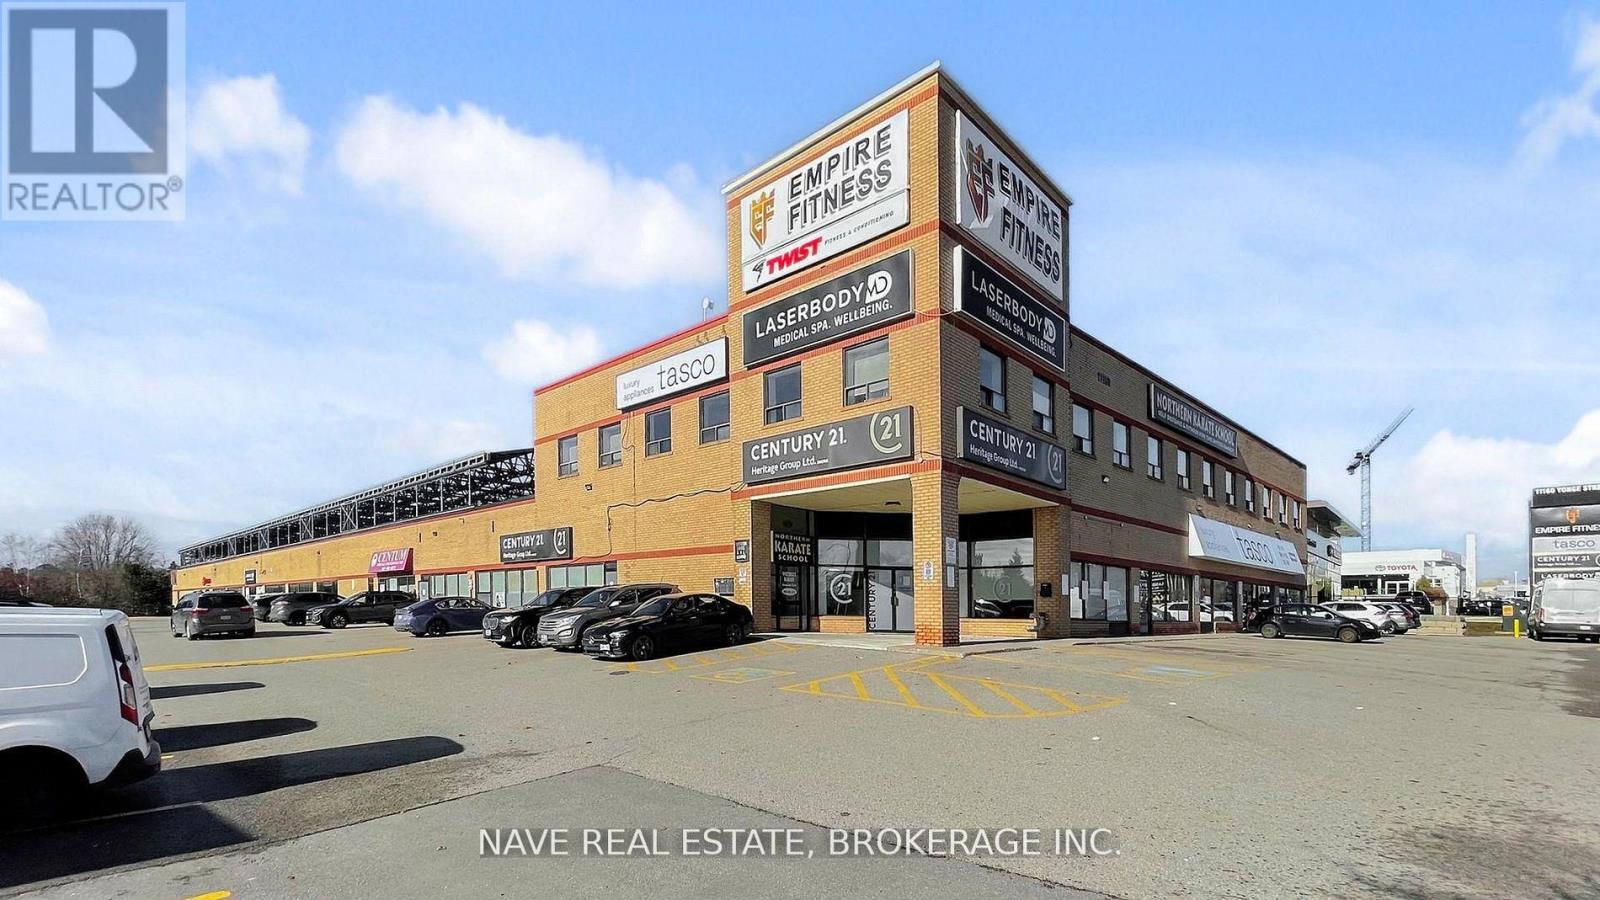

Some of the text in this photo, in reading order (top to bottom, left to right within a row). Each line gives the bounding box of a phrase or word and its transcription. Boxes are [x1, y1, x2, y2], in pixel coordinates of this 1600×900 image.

[788, 124, 892, 202] EMPIRE
[788, 159, 892, 234] FITNESS
[998, 160, 1061, 241] EMPIRE
[766, 236, 823, 274] TWIST
[1000, 206, 1061, 284] FITNESS
[773, 299, 893, 348] MEDICAL SPA. WELLBEING.
[986, 305, 1012, 331] MEDICAL
[1026, 331, 1057, 358] WELLBEING.
[623, 378, 640, 391] luxury
[657, 354, 715, 390] tasco
[623, 385, 655, 402] appliances
[1156, 392, 1192, 425] NORTHERN
[1192, 413, 1215, 437] KARATE
[1215, 425, 1235, 447] SCHOOL
[751, 430, 825, 461] CENTURY
[969, 419, 1036, 460] CENTURY 21
[751, 463, 779, 476] Heritage
[780, 459, 801, 470] Group
[802, 456, 817, 466] Ltd.
[969, 444, 993, 462] Heritage
[993, 452, 1010, 469] Group
[503, 534, 536, 549] CENTURY
[774, 533, 811, 542] NORTHERN
[1535, 526, 1571, 534] EMPIRE
[1553, 539, 1596, 549] tasco
[774, 540, 812, 556] KARATE
[778, 554, 809, 563] SCHOOL
[1235, 531, 1274, 564] tasco
[868, 581, 876, 630] CENTURY
